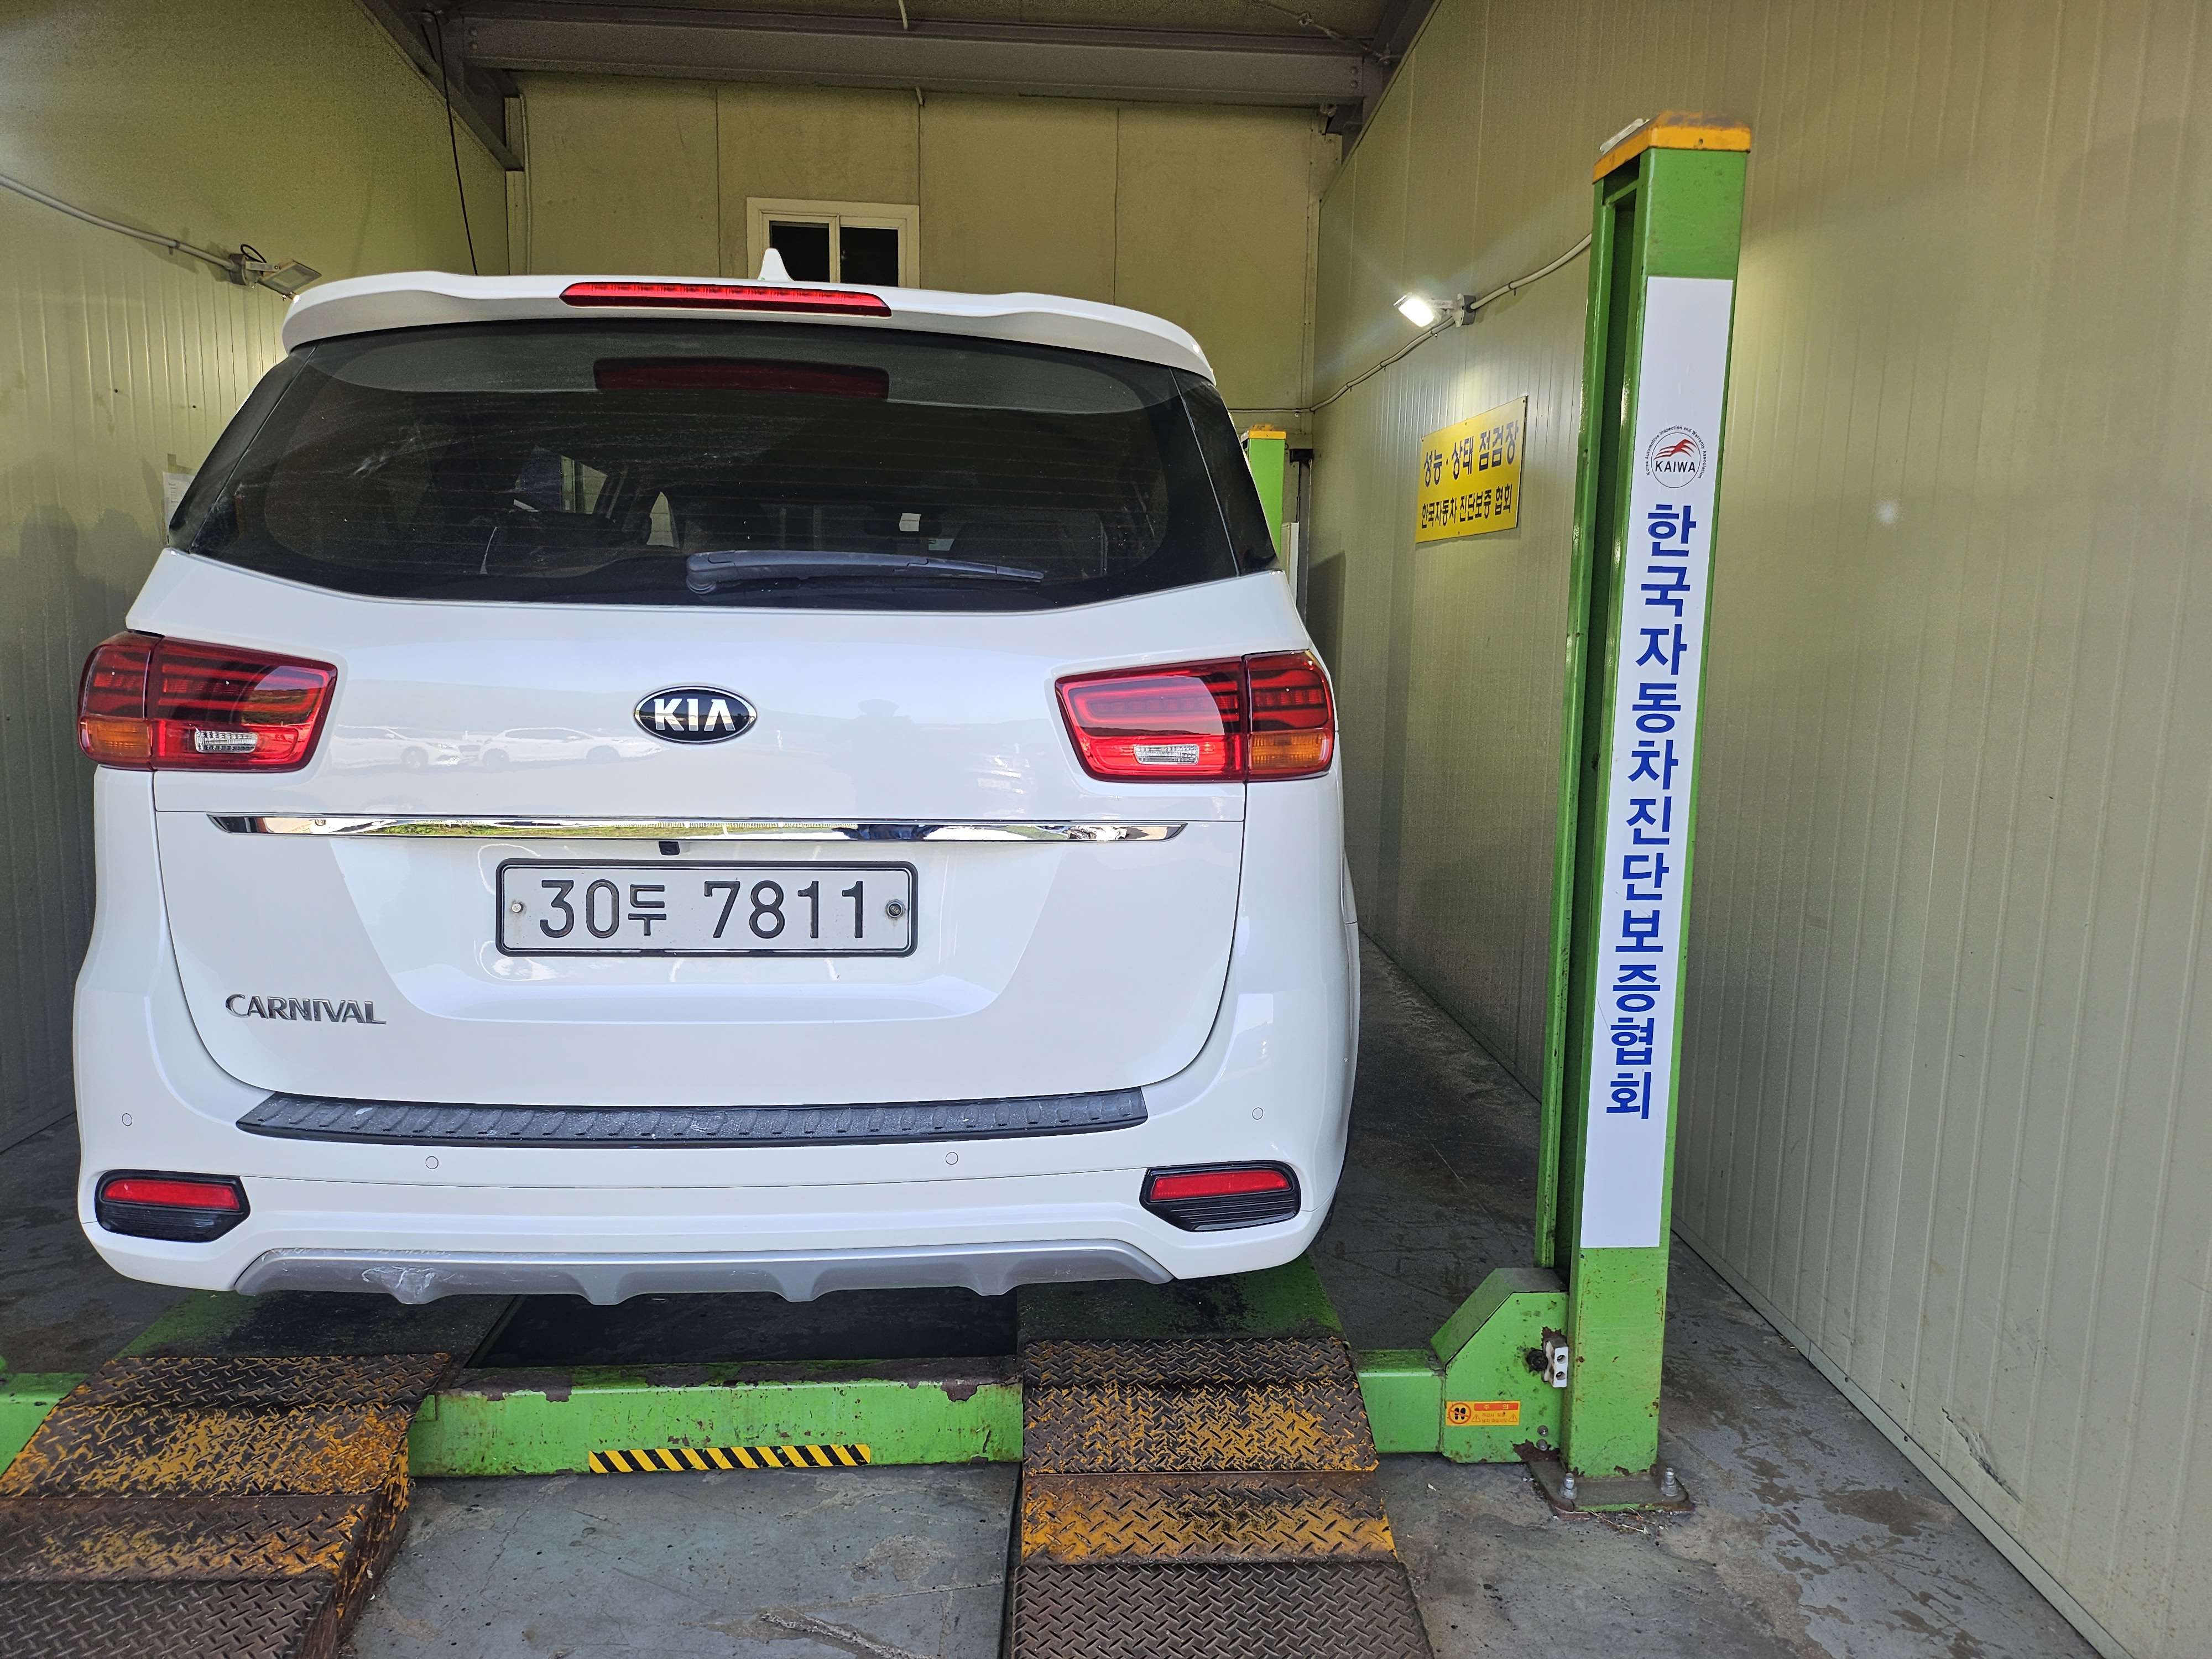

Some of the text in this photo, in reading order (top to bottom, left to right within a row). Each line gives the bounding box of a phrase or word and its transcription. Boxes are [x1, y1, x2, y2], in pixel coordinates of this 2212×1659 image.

[1479, 420, 1519, 472] 점검장
[1655, 461, 1696, 473] KAIWA
[1421, 483, 1512, 529] 한국자동차 진단보증 협회
[653, 698, 736, 732] KIA
[1605, 503, 1697, 1120] 한국자동차진단보증협회
[539, 879, 864, 940] 30두 7811
[225, 994, 387, 1024] CARNIVAL
